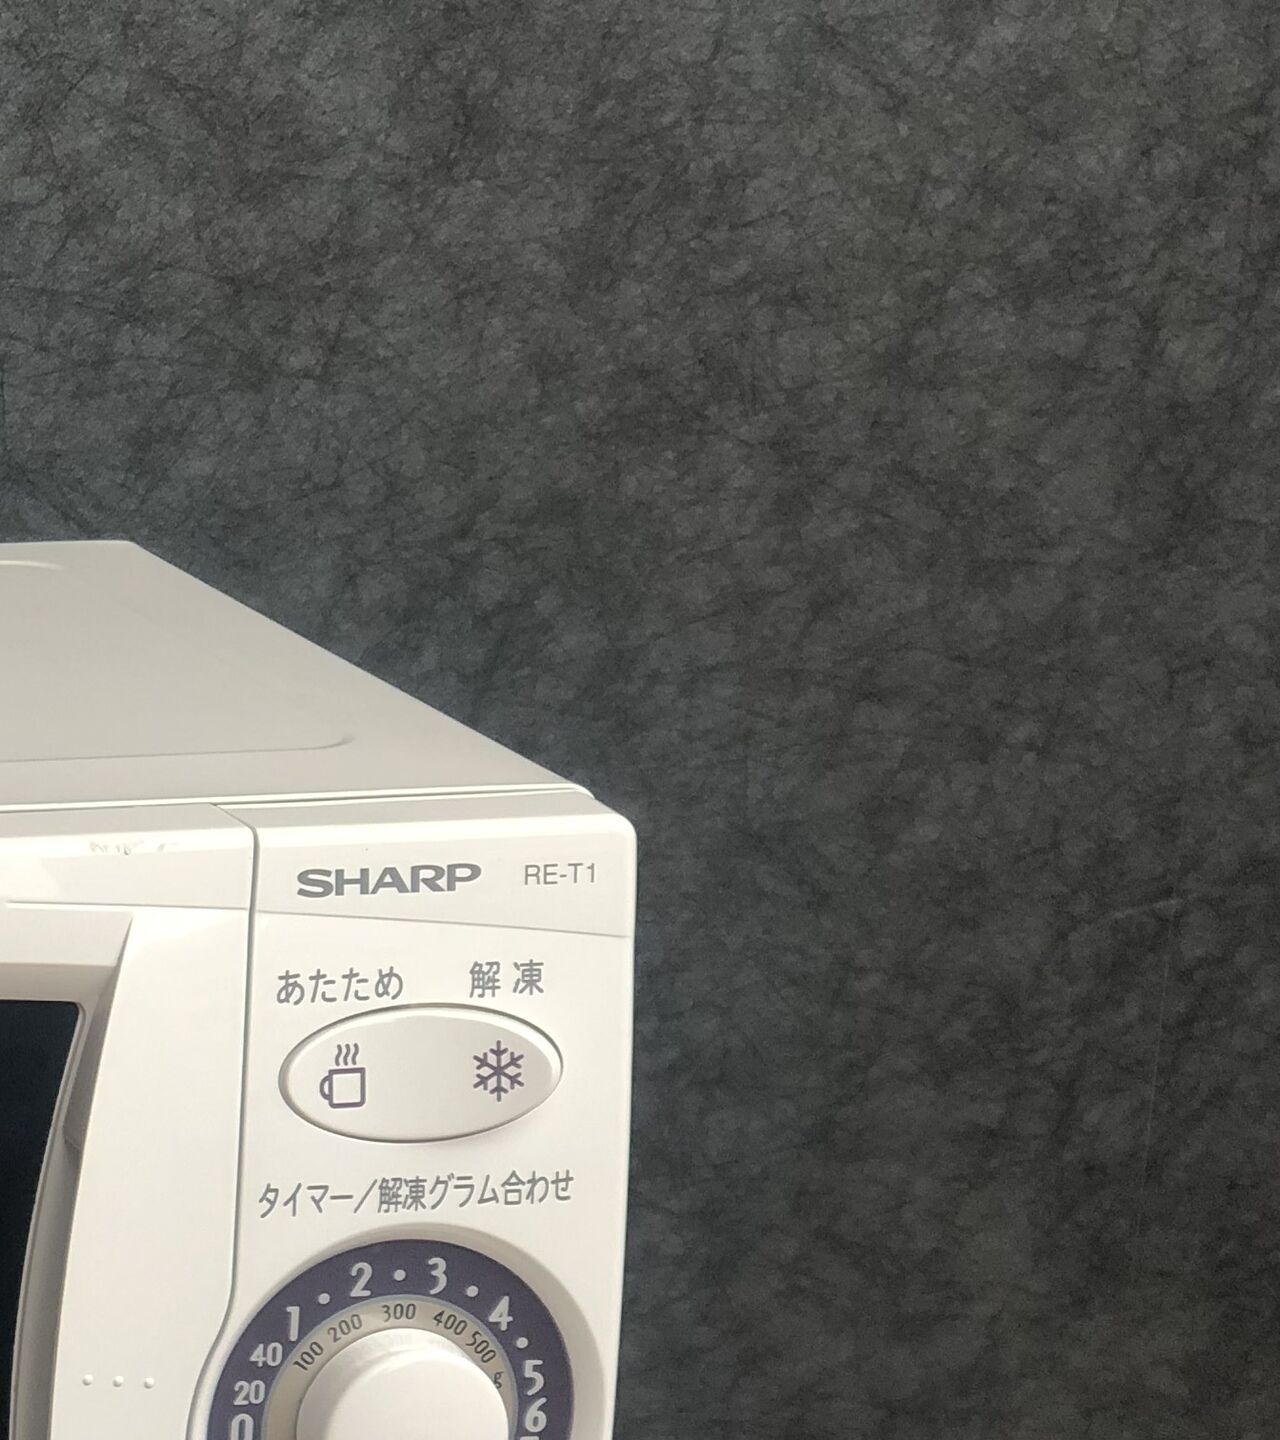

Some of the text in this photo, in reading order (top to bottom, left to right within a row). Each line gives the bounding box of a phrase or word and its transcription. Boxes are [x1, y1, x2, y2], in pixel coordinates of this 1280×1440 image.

[296, 862, 597, 898] SHARP RE-T1
[276, 958, 545, 1005] あたため 解凍
[349, 1262, 373, 1298] 2
[427, 1257, 447, 1294] 3
[286, 1306, 301, 1342] 1
[487, 1296, 513, 1332] 4
[250, 1342, 283, 1367] 40
[292, 1340, 325, 1371] 100
[326, 1313, 363, 1343] 200
[381, 1303, 417, 1322] 300
[432, 1309, 468, 1337] 400
[464, 1330, 498, 1364] 500
[233, 1379, 266, 1406] 20
[523, 1359, 545, 1396] 5
[524, 1397, 547, 1433] 6
